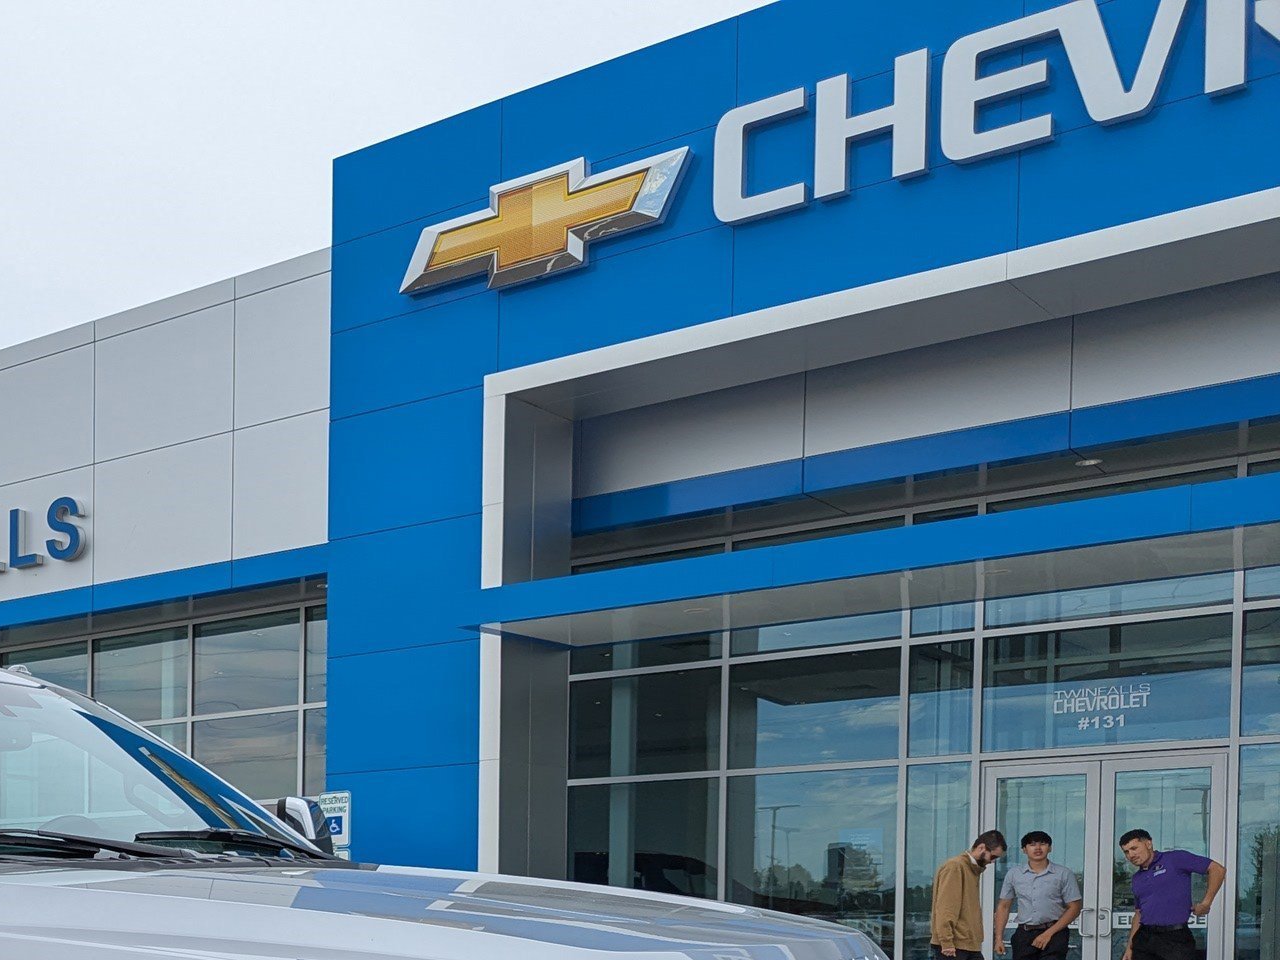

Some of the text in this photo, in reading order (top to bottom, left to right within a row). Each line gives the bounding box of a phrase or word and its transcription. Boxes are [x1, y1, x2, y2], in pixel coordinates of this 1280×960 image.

[1053, 692, 1151, 714] CHEVROLET
[1078, 714, 1126, 730] #131
[322, 806, 347, 814] PARKING
